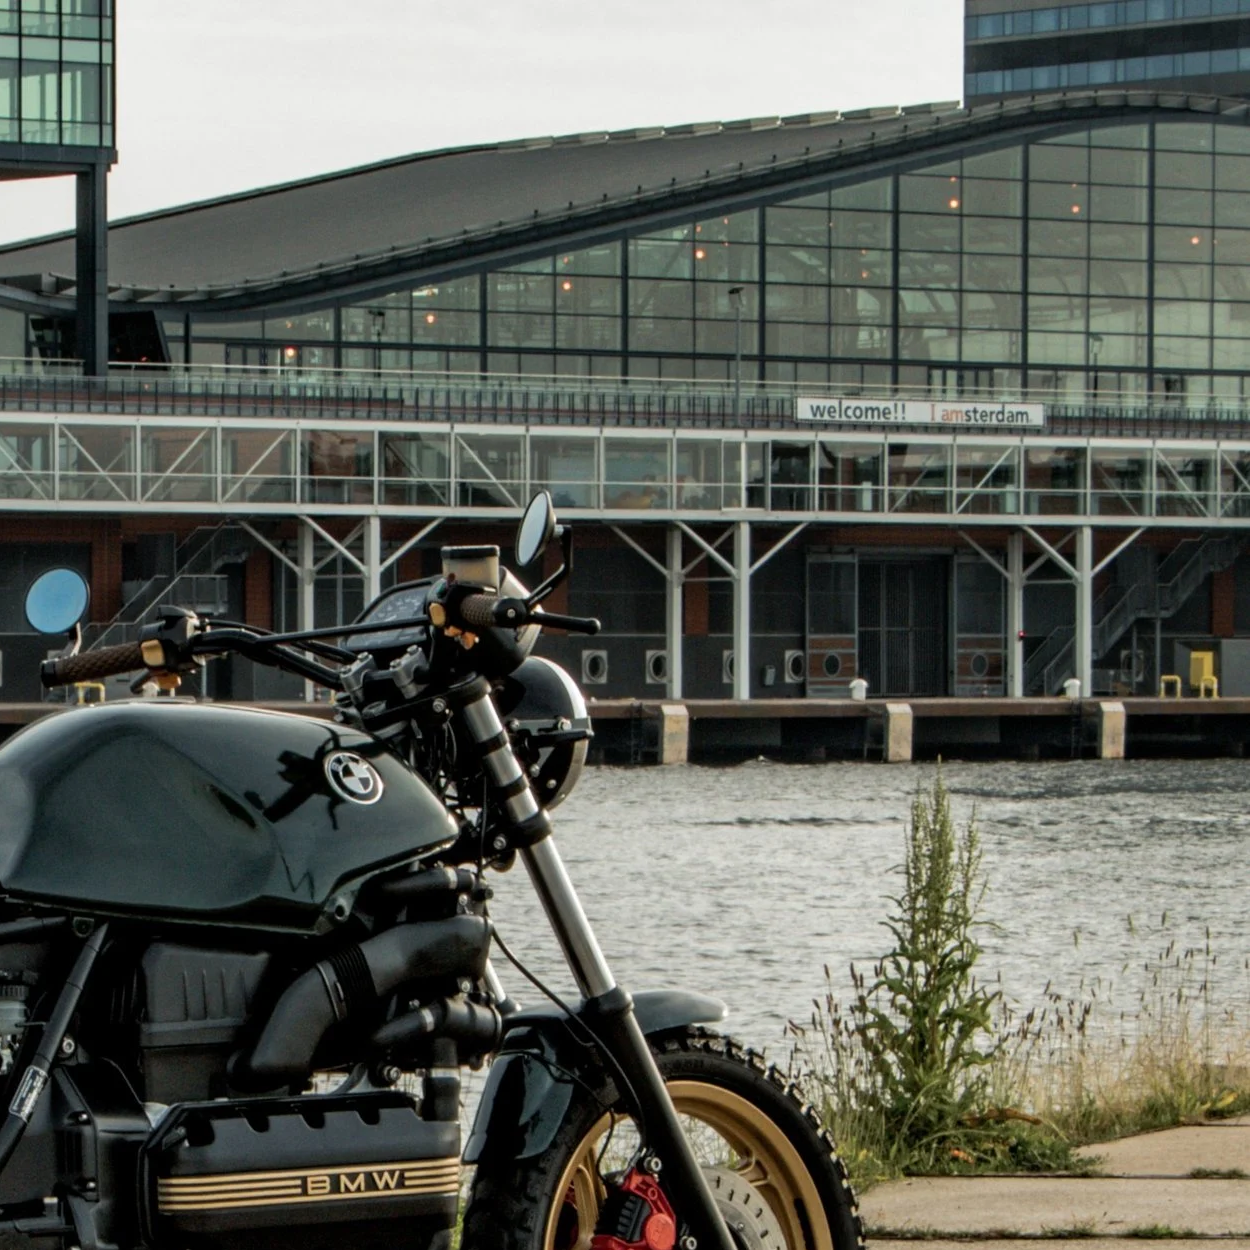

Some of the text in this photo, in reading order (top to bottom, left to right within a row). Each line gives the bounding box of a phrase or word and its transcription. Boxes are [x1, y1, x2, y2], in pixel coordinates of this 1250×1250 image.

[810, 400, 906, 421] welcome!!
[930, 404, 936, 422] I
[306, 1170, 400, 1196] BMW
